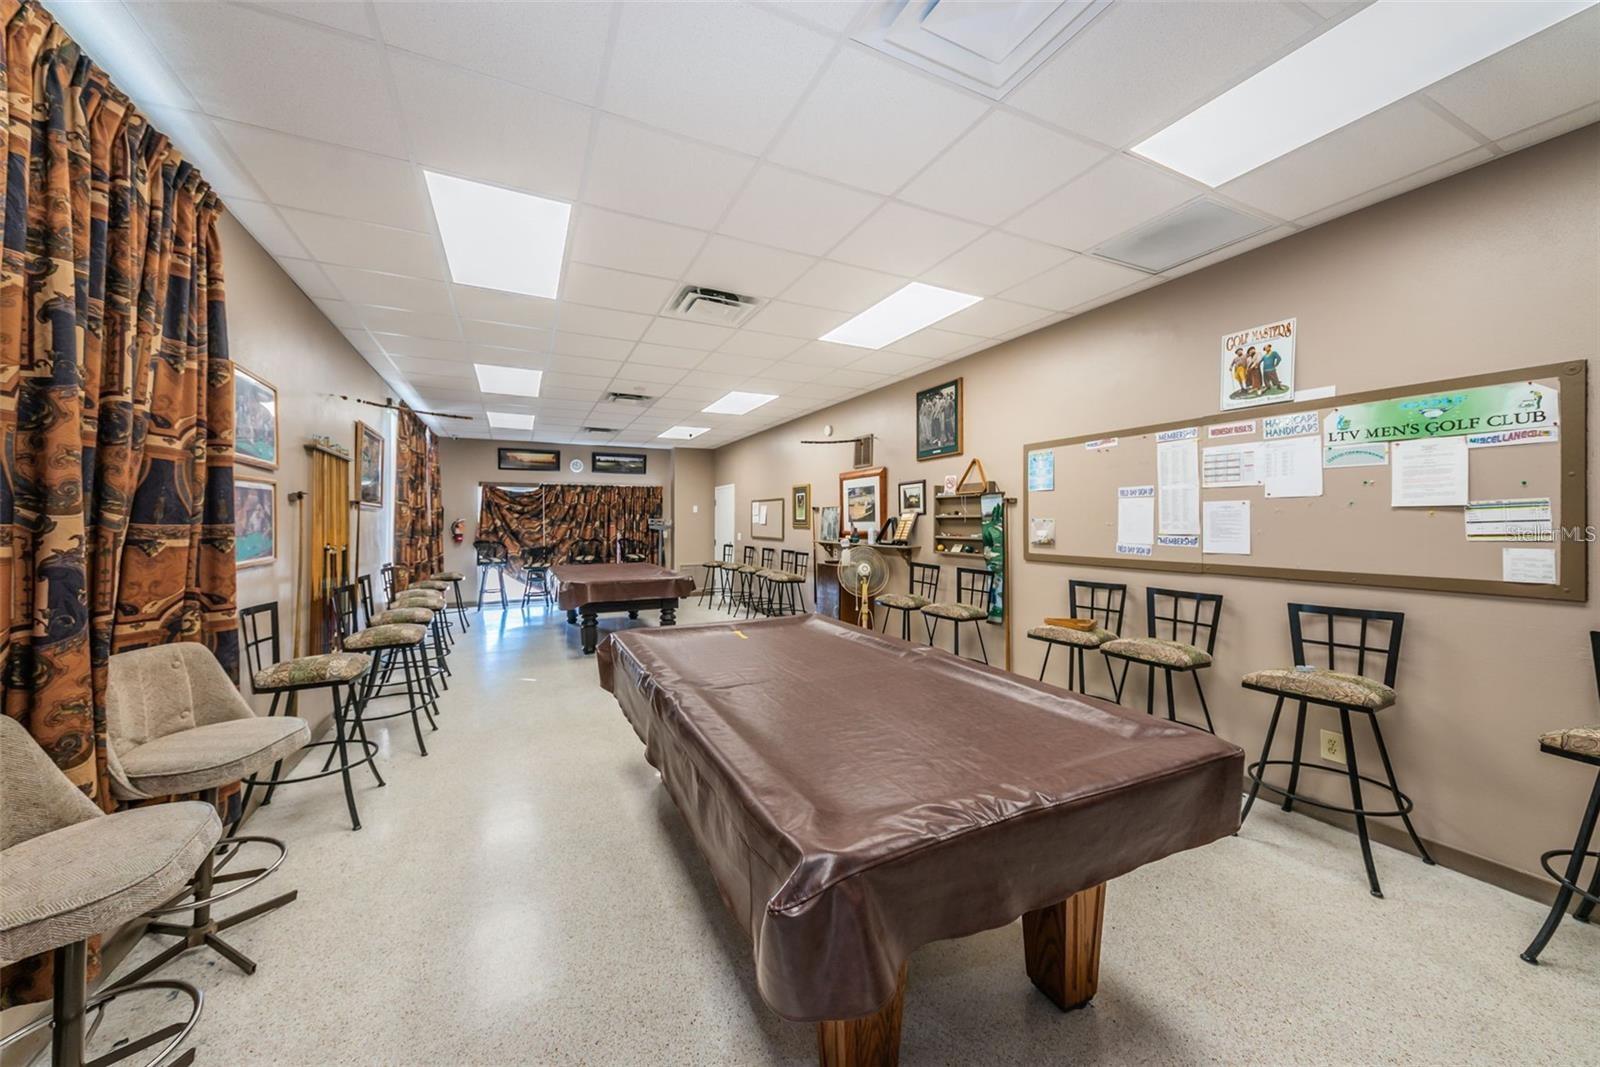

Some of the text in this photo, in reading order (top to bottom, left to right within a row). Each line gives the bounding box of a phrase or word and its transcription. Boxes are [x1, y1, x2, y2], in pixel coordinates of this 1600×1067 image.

[1226, 322, 1292, 351] GOLF MASTERS
[1265, 413, 1317, 428] HAICAPS
[1328, 410, 1546, 442] LTV MEN'S GOLF CLUB
[1265, 423, 1318, 437] HANDICAPS
[1159, 537, 1198, 546] MEMBERSHIP
